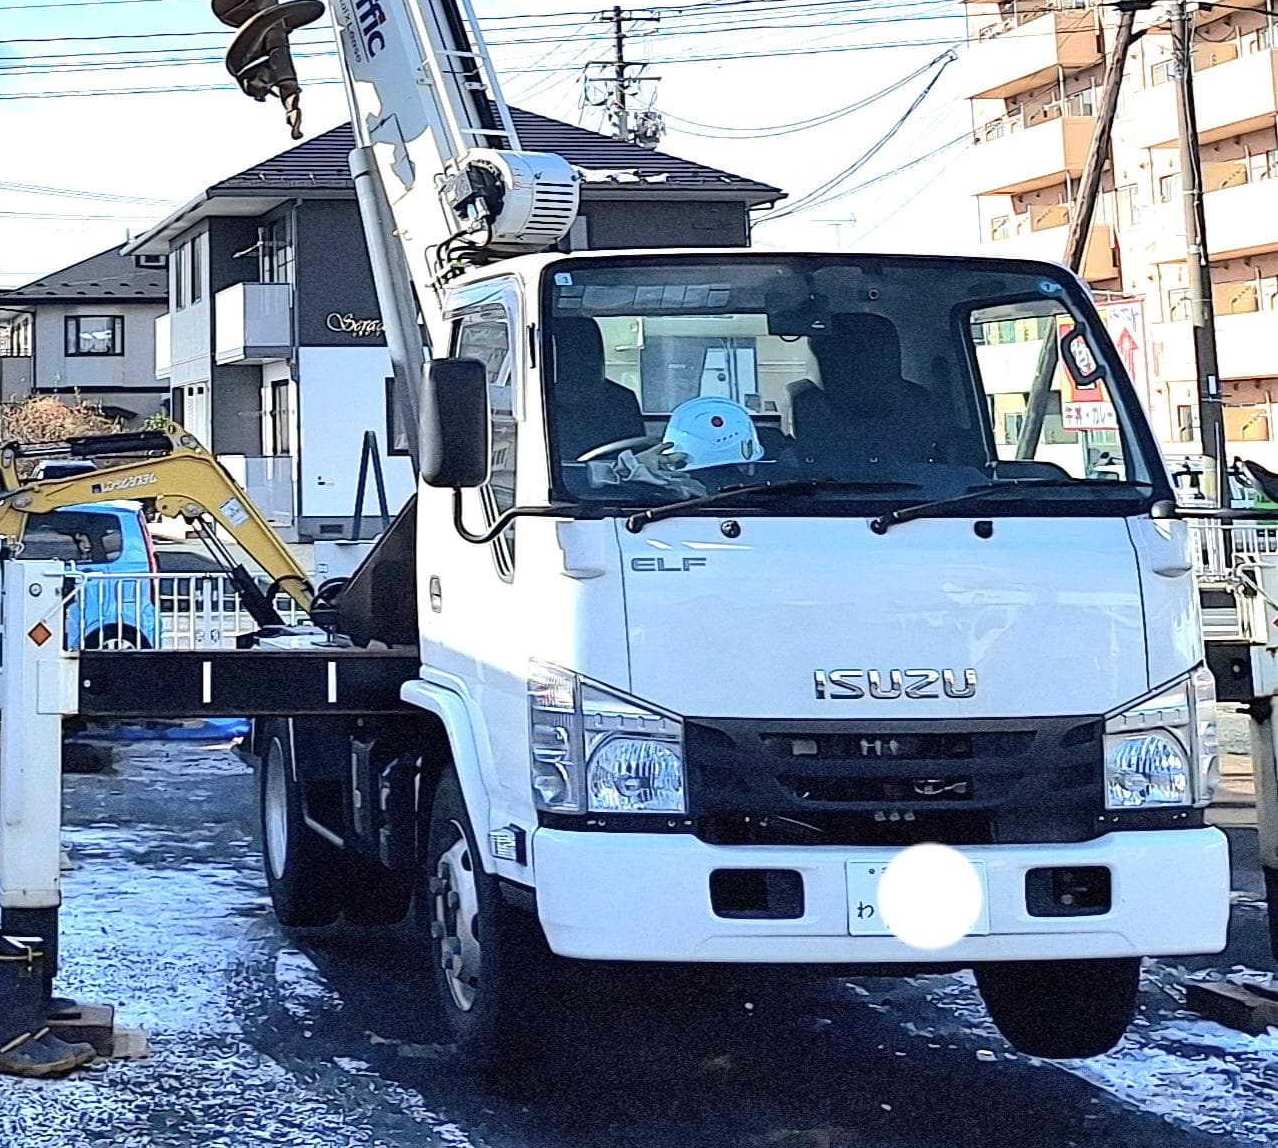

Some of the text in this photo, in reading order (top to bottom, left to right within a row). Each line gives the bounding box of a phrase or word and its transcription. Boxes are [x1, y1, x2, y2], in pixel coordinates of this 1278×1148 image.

[631, 557, 707, 572] ELF
[813, 668, 978, 700] ISUZU
[857, 901, 875, 919] わ
